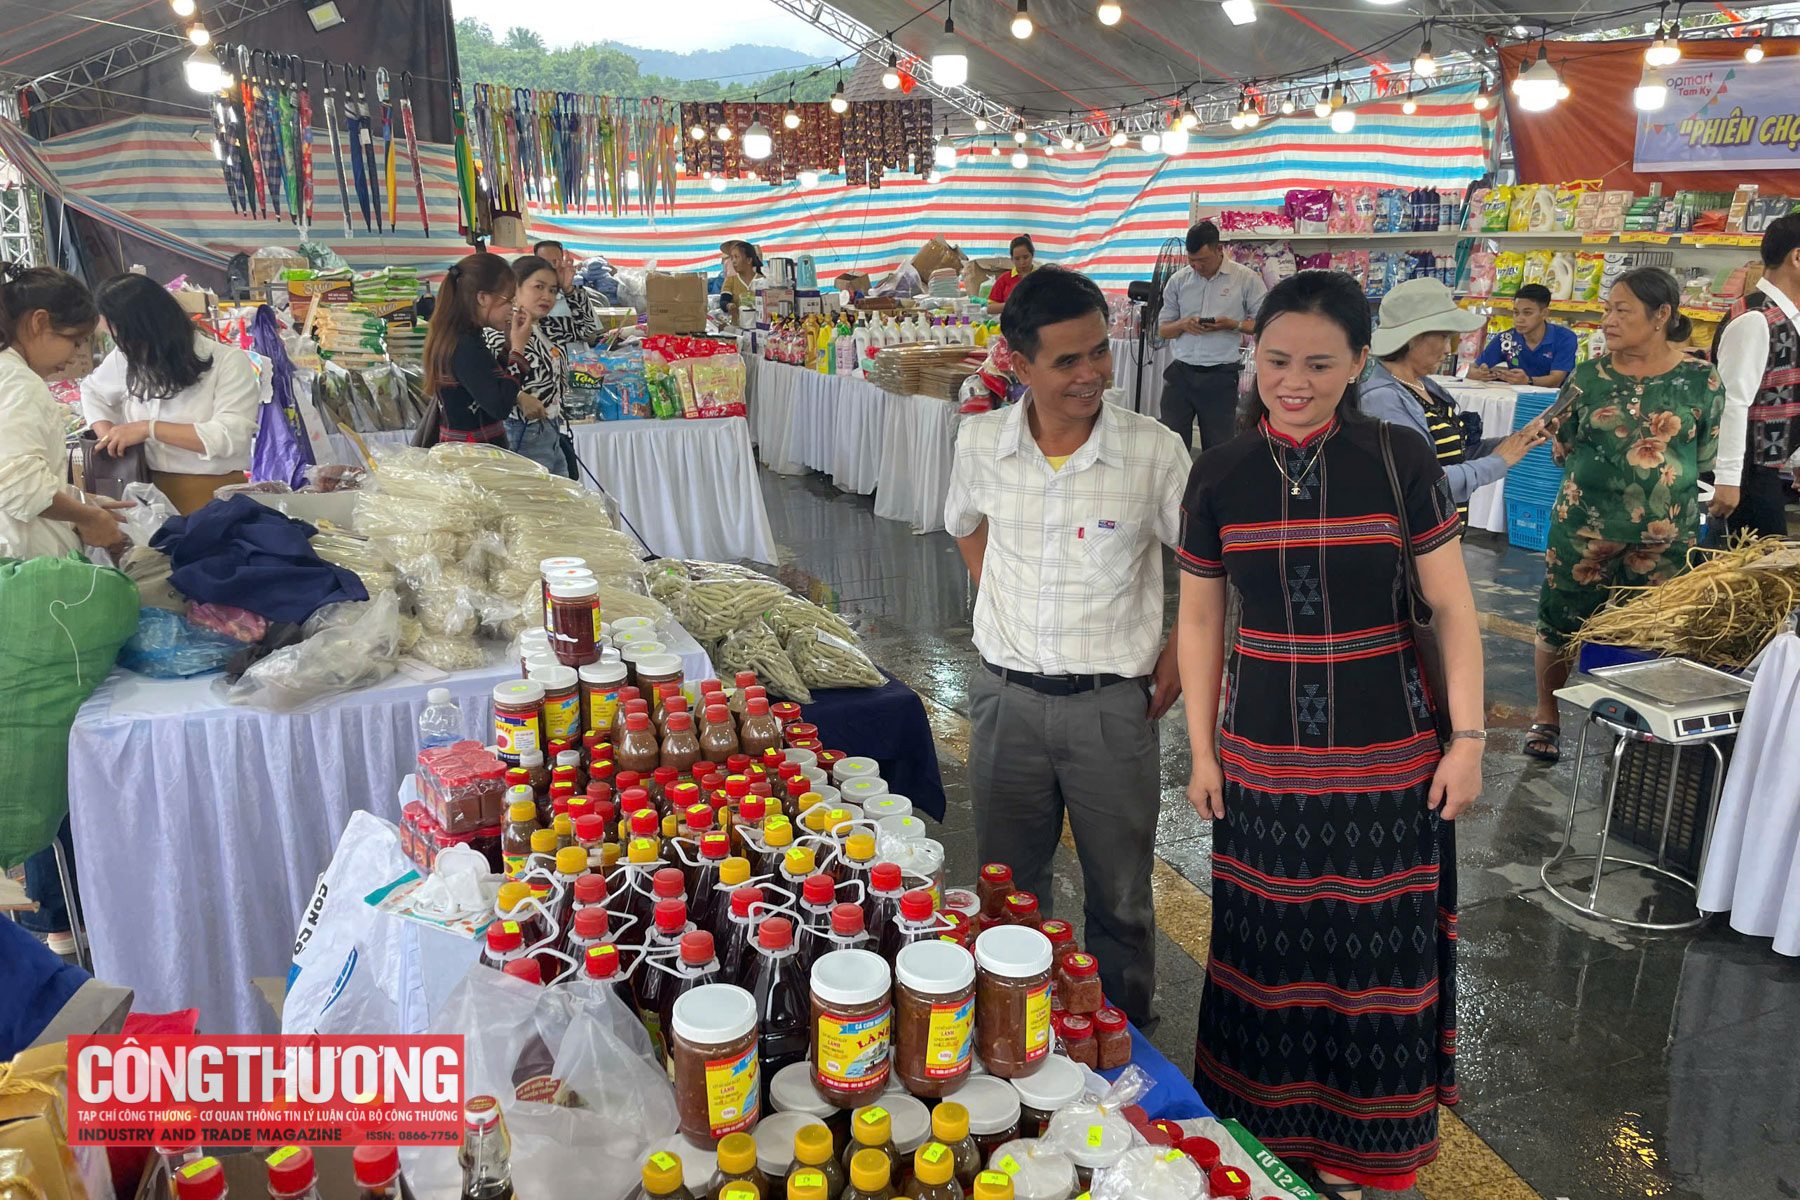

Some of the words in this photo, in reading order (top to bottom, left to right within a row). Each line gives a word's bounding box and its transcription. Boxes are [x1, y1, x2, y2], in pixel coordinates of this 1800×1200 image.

[1678, 87, 1698, 97] Tam
[307, 882, 328, 926] CON
[1273, 1167, 1293, 1188] 12
